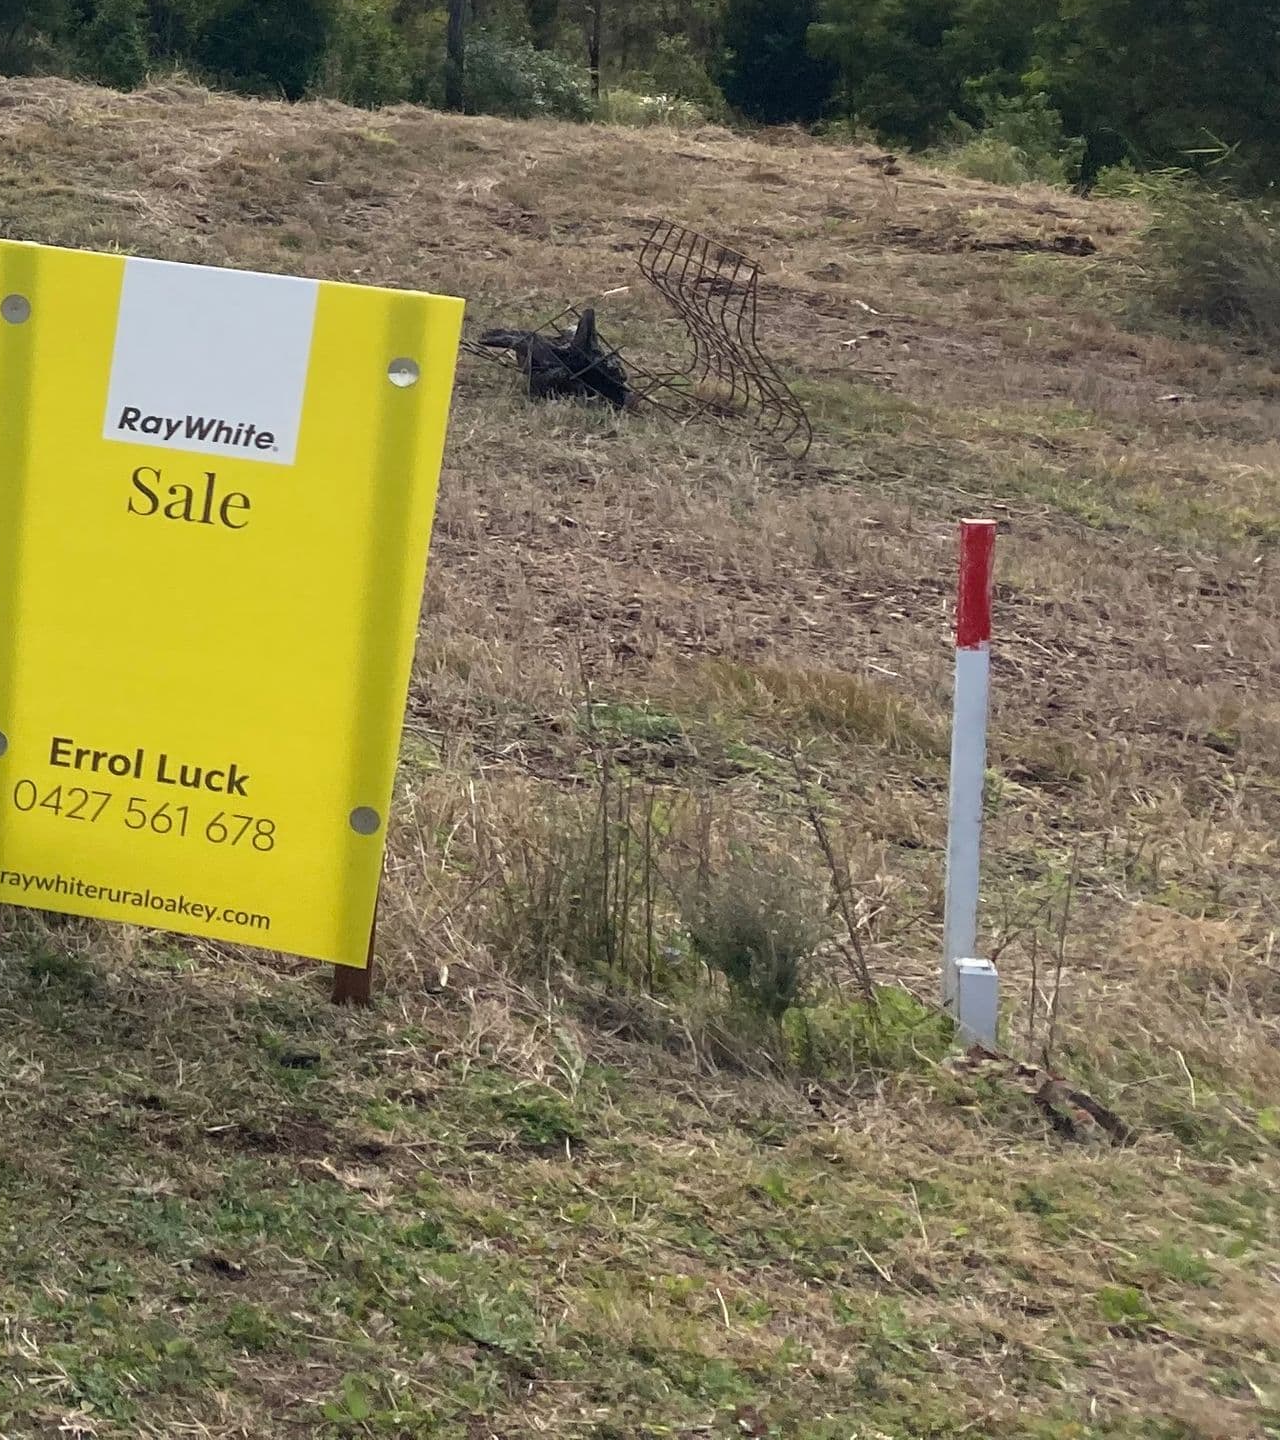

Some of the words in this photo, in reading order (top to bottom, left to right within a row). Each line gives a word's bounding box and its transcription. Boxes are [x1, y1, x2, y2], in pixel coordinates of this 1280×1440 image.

[127, 466, 251, 530] Sale
[49, 736, 144, 779] Errol
[156, 754, 250, 797] Luck
[13, 779, 112, 823] 0427
[124, 796, 189, 837] 561
[205, 811, 276, 852] 678
[0, 868, 271, 930] raywhiteruraloakey.com
